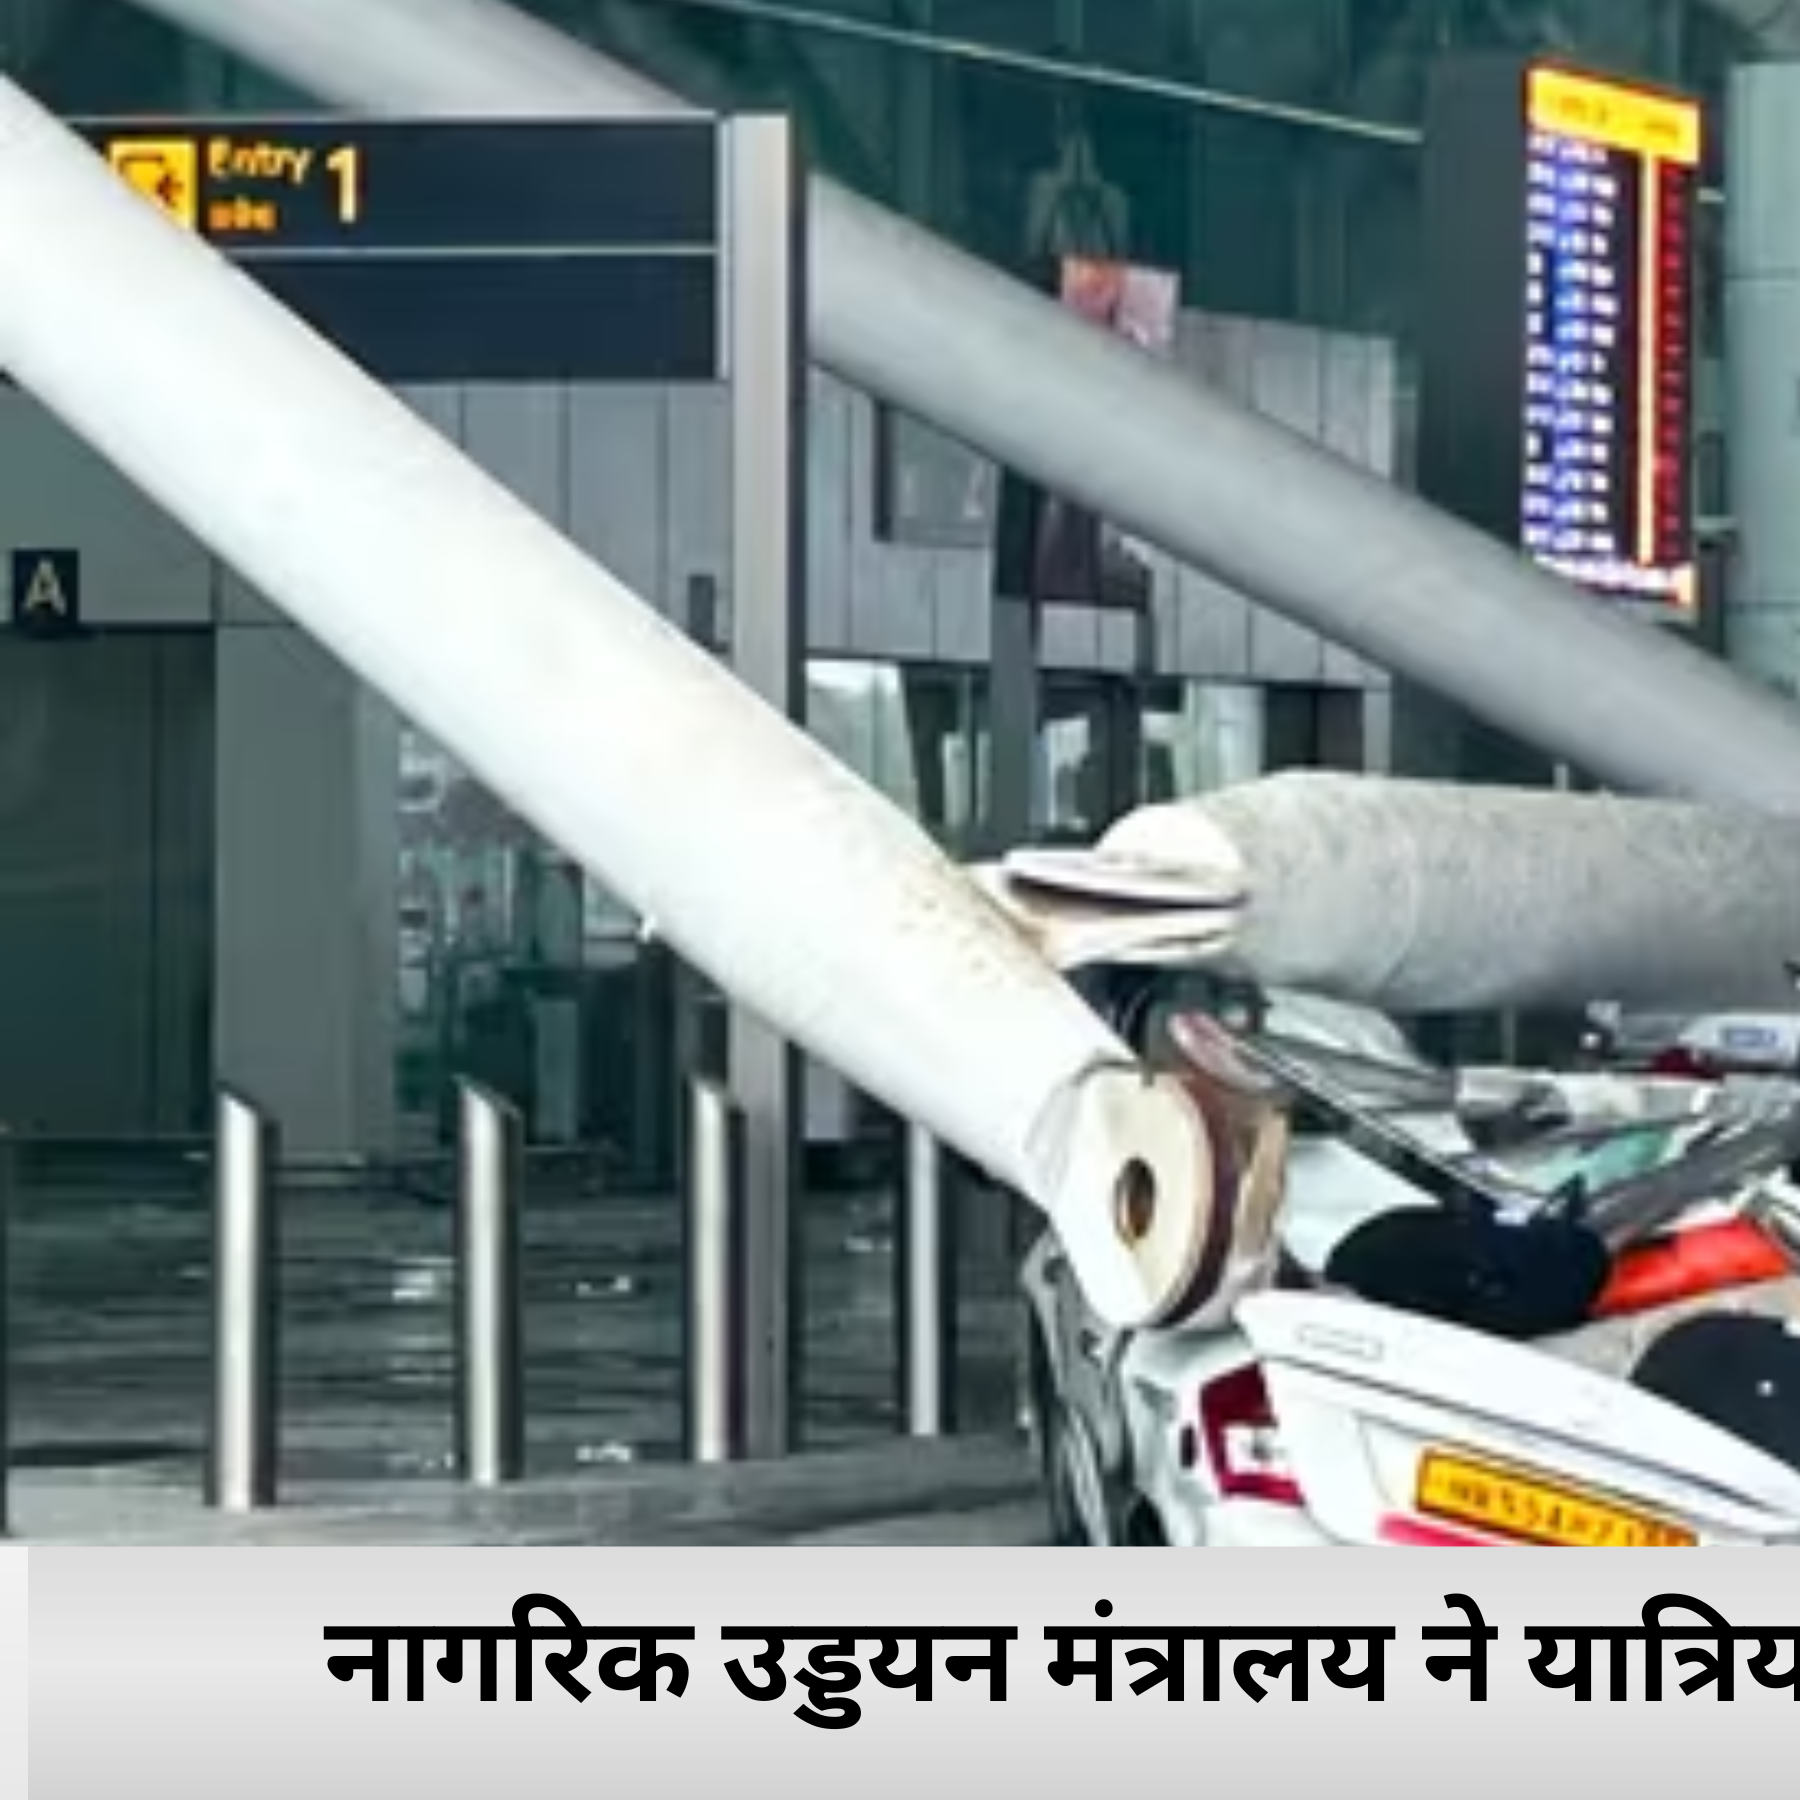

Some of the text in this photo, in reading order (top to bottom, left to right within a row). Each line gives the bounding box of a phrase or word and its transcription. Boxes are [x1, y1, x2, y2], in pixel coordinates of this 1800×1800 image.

[208, 137, 312, 185] Entry
[325, 145, 358, 224] 1
[26, 559, 68, 617] A
